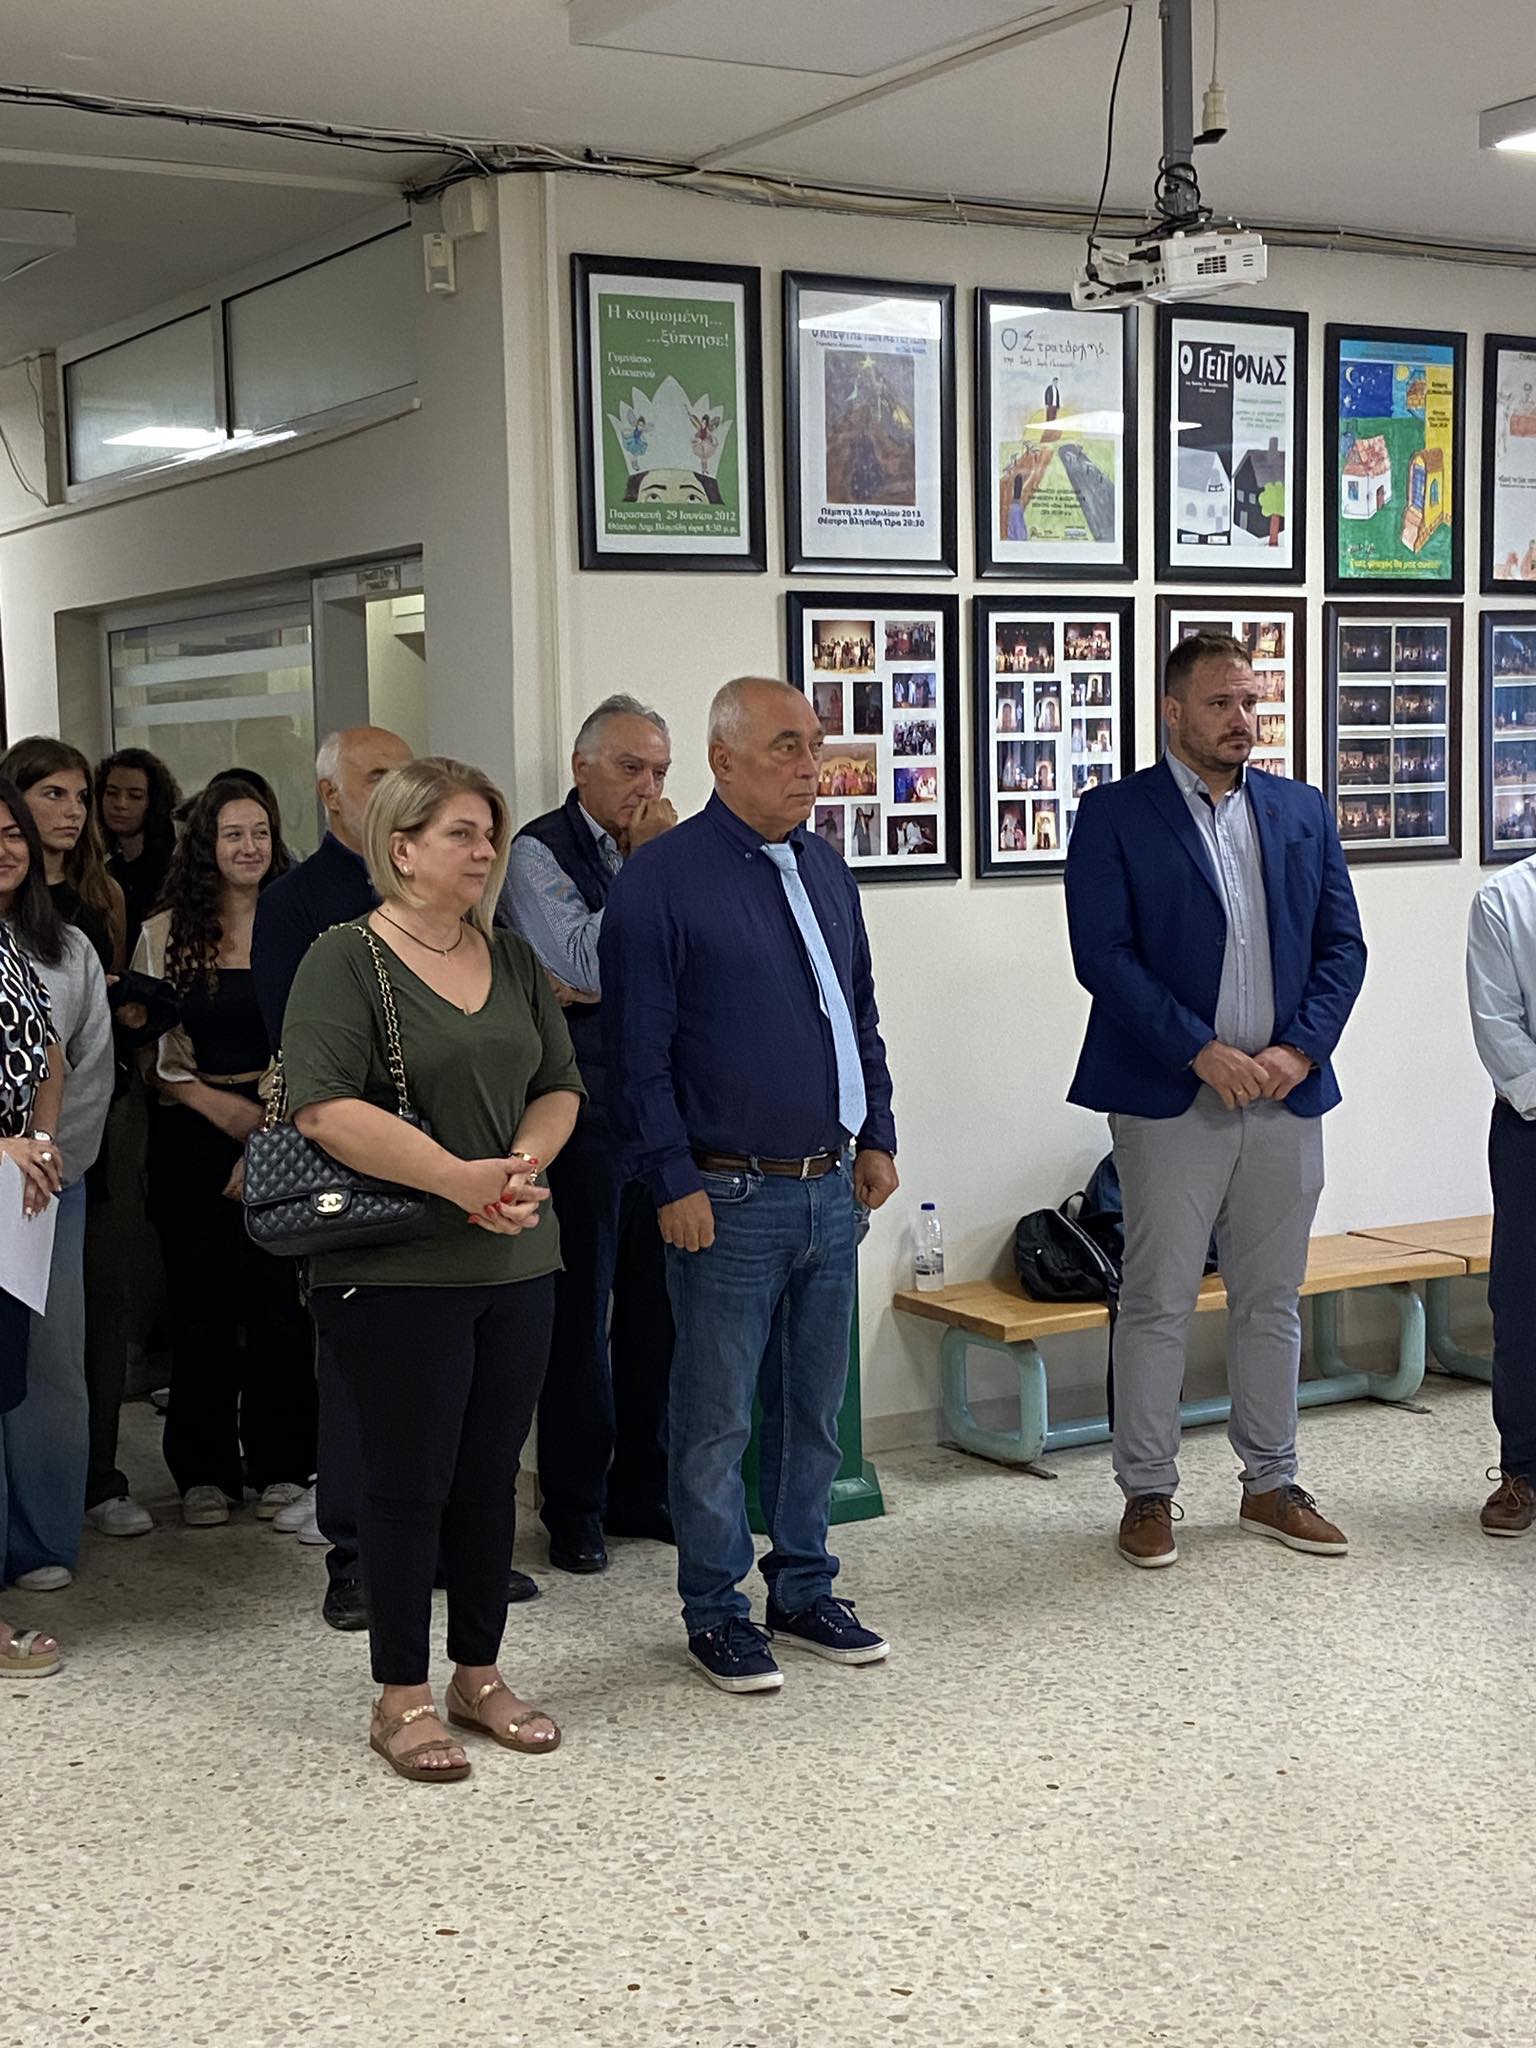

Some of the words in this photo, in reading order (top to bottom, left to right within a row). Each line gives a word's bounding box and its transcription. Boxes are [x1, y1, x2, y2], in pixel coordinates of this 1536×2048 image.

[608, 304, 620, 319] Η
[626, 308, 722, 327] κοιμωμένη...
[647, 330, 729, 348] ...ξύπνησε!
[1001, 328, 1018, 351] Ο
[1180, 345, 1193, 375] Ο
[1199, 347, 1287, 386] ΓΕΙΤΟΝΑΣ
[609, 508, 661, 521] Παρασκευή
[666, 510, 678, 520] 29
[680, 510, 712, 520] Ιουνίου
[715, 511, 737, 521] 2012
[821, 507, 851, 517] Πέμπτη
